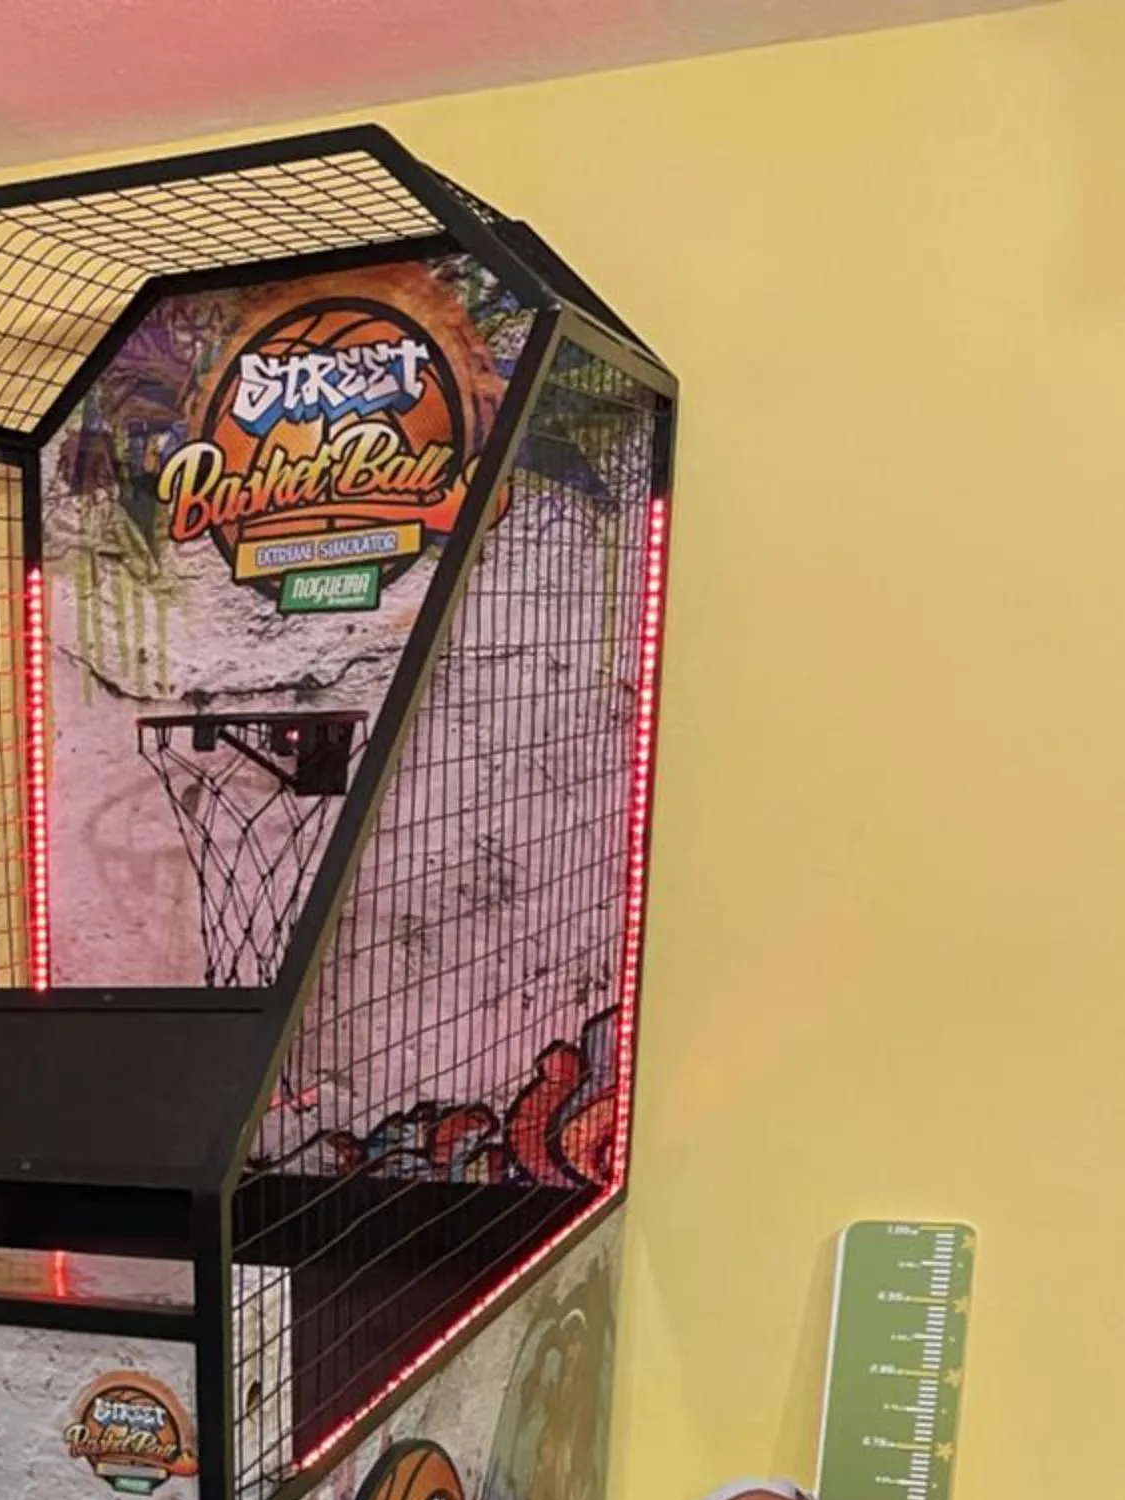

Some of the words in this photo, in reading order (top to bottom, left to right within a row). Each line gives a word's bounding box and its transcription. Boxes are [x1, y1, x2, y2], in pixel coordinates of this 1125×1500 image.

[232, 340, 428, 420] STREET
[159, 442, 330, 538] Basket
[331, 423, 453, 495] Ball
[292, 572, 370, 605] NOGUEIRA
